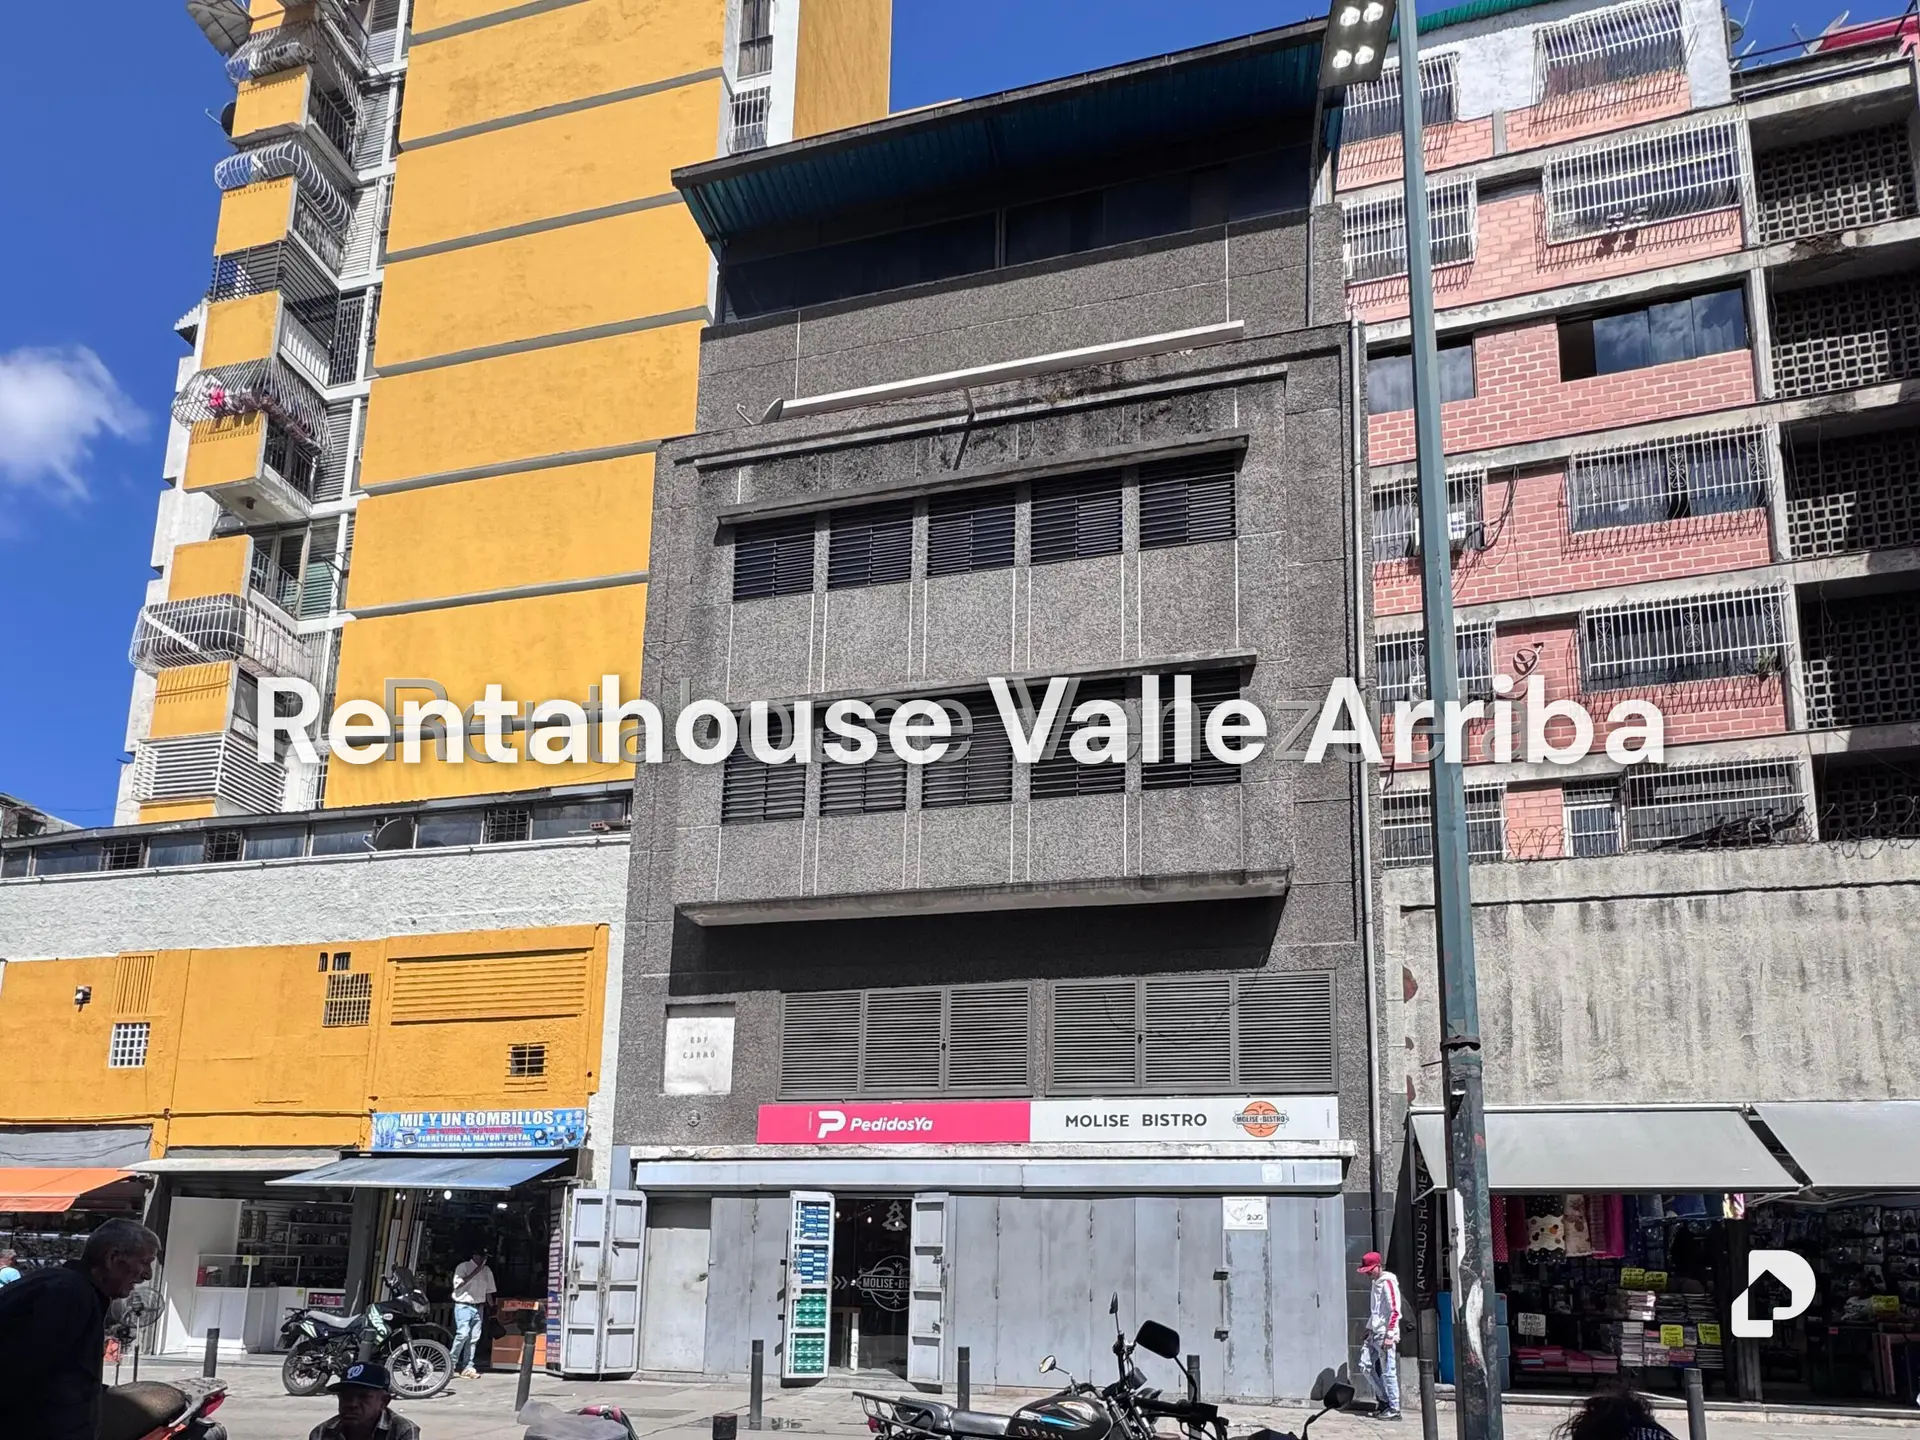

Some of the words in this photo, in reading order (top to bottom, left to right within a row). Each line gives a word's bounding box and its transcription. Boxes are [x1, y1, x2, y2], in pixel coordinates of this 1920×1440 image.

[400, 1113, 425, 1127] MIL
[428, 1112, 440, 1127] Y
[441, 1112, 461, 1127] UN
[465, 1110, 554, 1126] BOMBILLOS
[850, 1116, 933, 1132] PedidosYa
[1065, 1114, 1130, 1127] MOLISE
[1142, 1113, 1208, 1127] BISTRO
[1236, 1115, 1259, 1123] MOLISE
[1262, 1115, 1285, 1123] BISTRO
[862, 1277, 894, 1289] MOLISE
